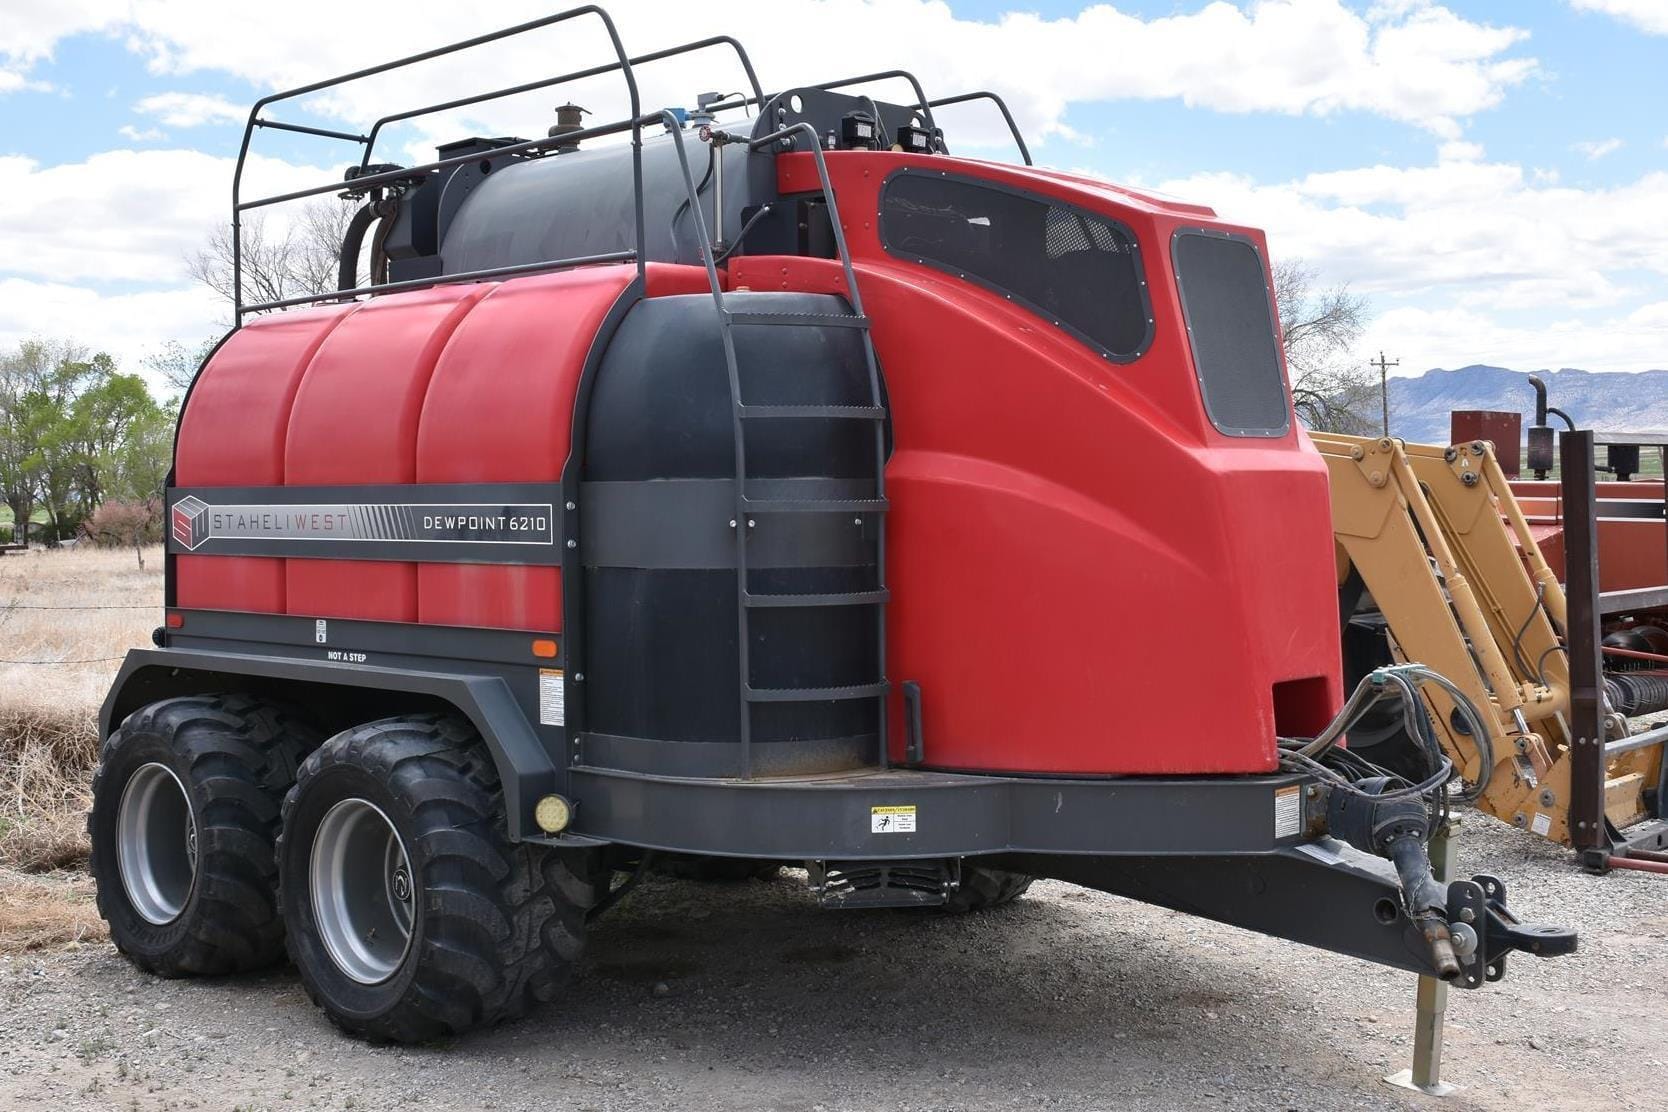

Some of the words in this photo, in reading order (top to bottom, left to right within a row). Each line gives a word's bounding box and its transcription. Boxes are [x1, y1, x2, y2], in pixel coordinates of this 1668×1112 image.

[213, 514, 290, 531] STAHELI
[294, 514, 349, 531] WEST
[423, 516, 507, 530] DEWPOINT
[509, 516, 546, 531] 6210
[328, 651, 342, 660] NOT
[349, 653, 367, 662] STEP
